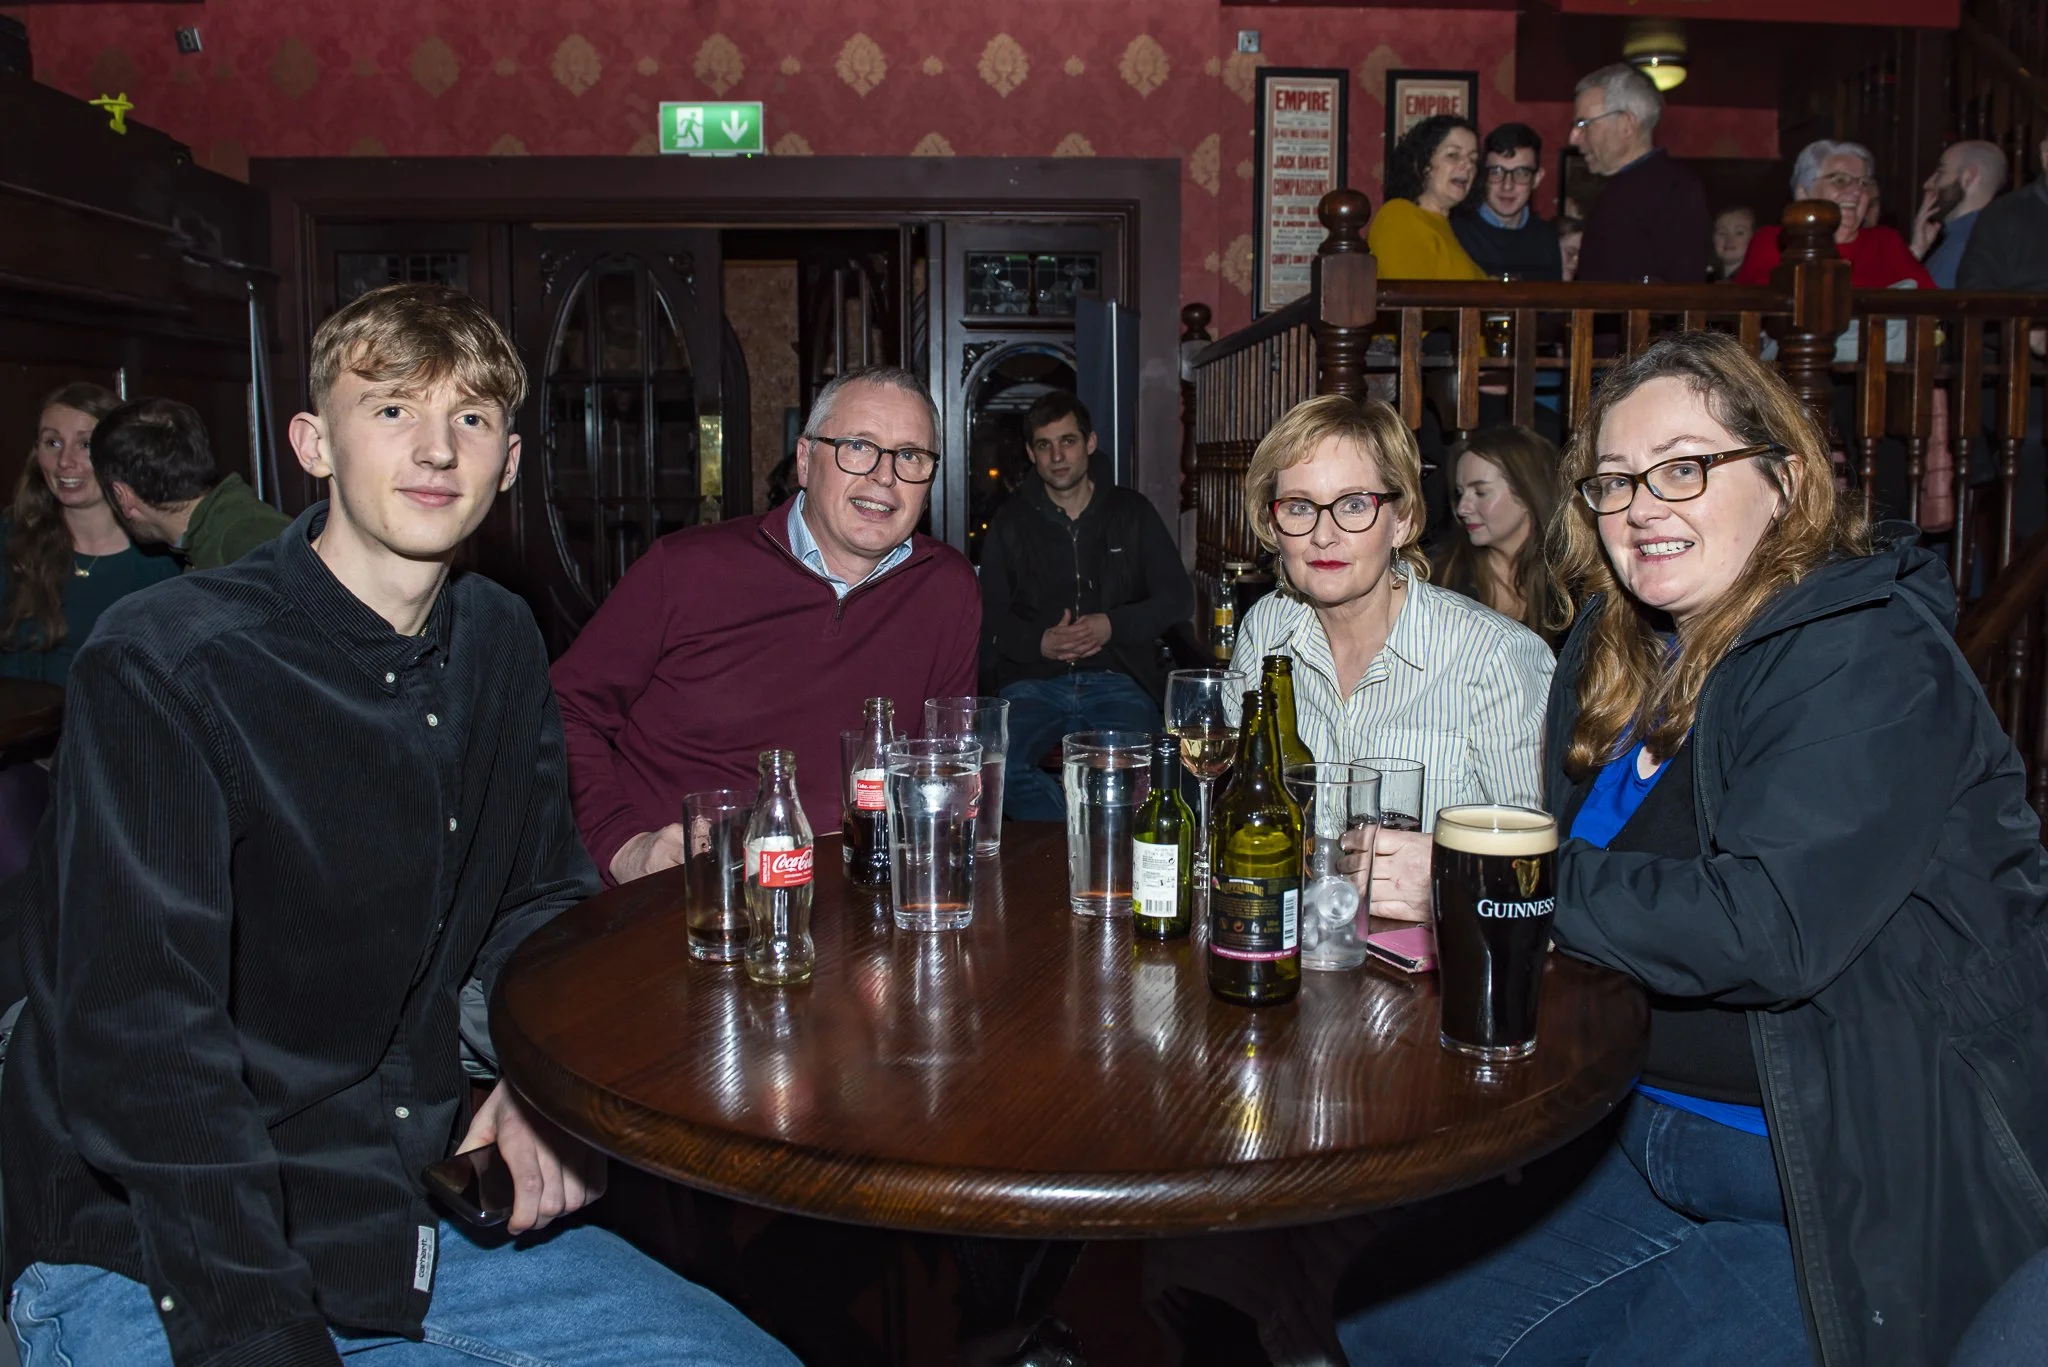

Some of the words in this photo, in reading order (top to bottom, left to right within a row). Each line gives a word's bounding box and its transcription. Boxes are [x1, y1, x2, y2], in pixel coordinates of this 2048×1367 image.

[1275, 90, 1330, 112] EMPIRE
[1406, 95, 1460, 115] EMPIRE
[1477, 897, 1555, 918] GUINNESS
